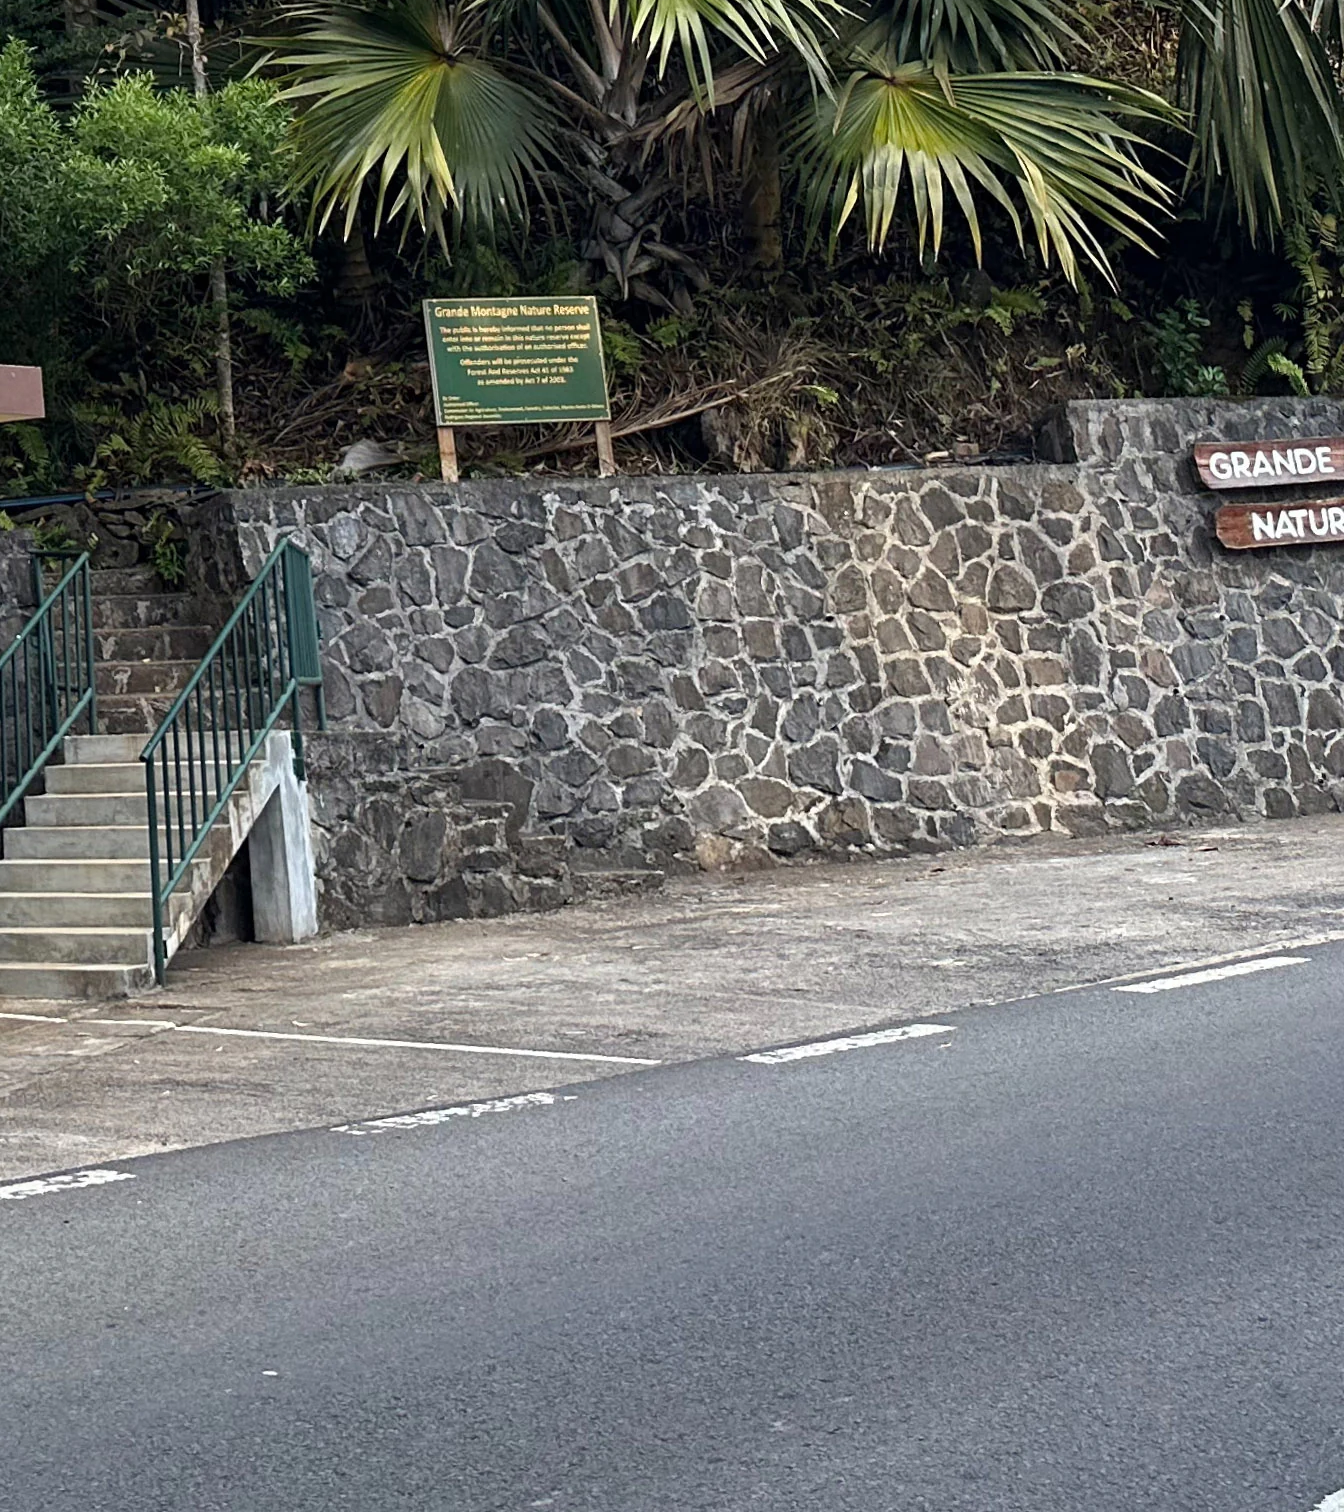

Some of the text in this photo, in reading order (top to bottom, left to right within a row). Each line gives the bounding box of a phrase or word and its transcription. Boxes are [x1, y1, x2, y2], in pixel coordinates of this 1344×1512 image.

[435, 304, 589, 318] Grande Montagne Nature Reserve
[1209, 446, 1335, 480] GRANDE
